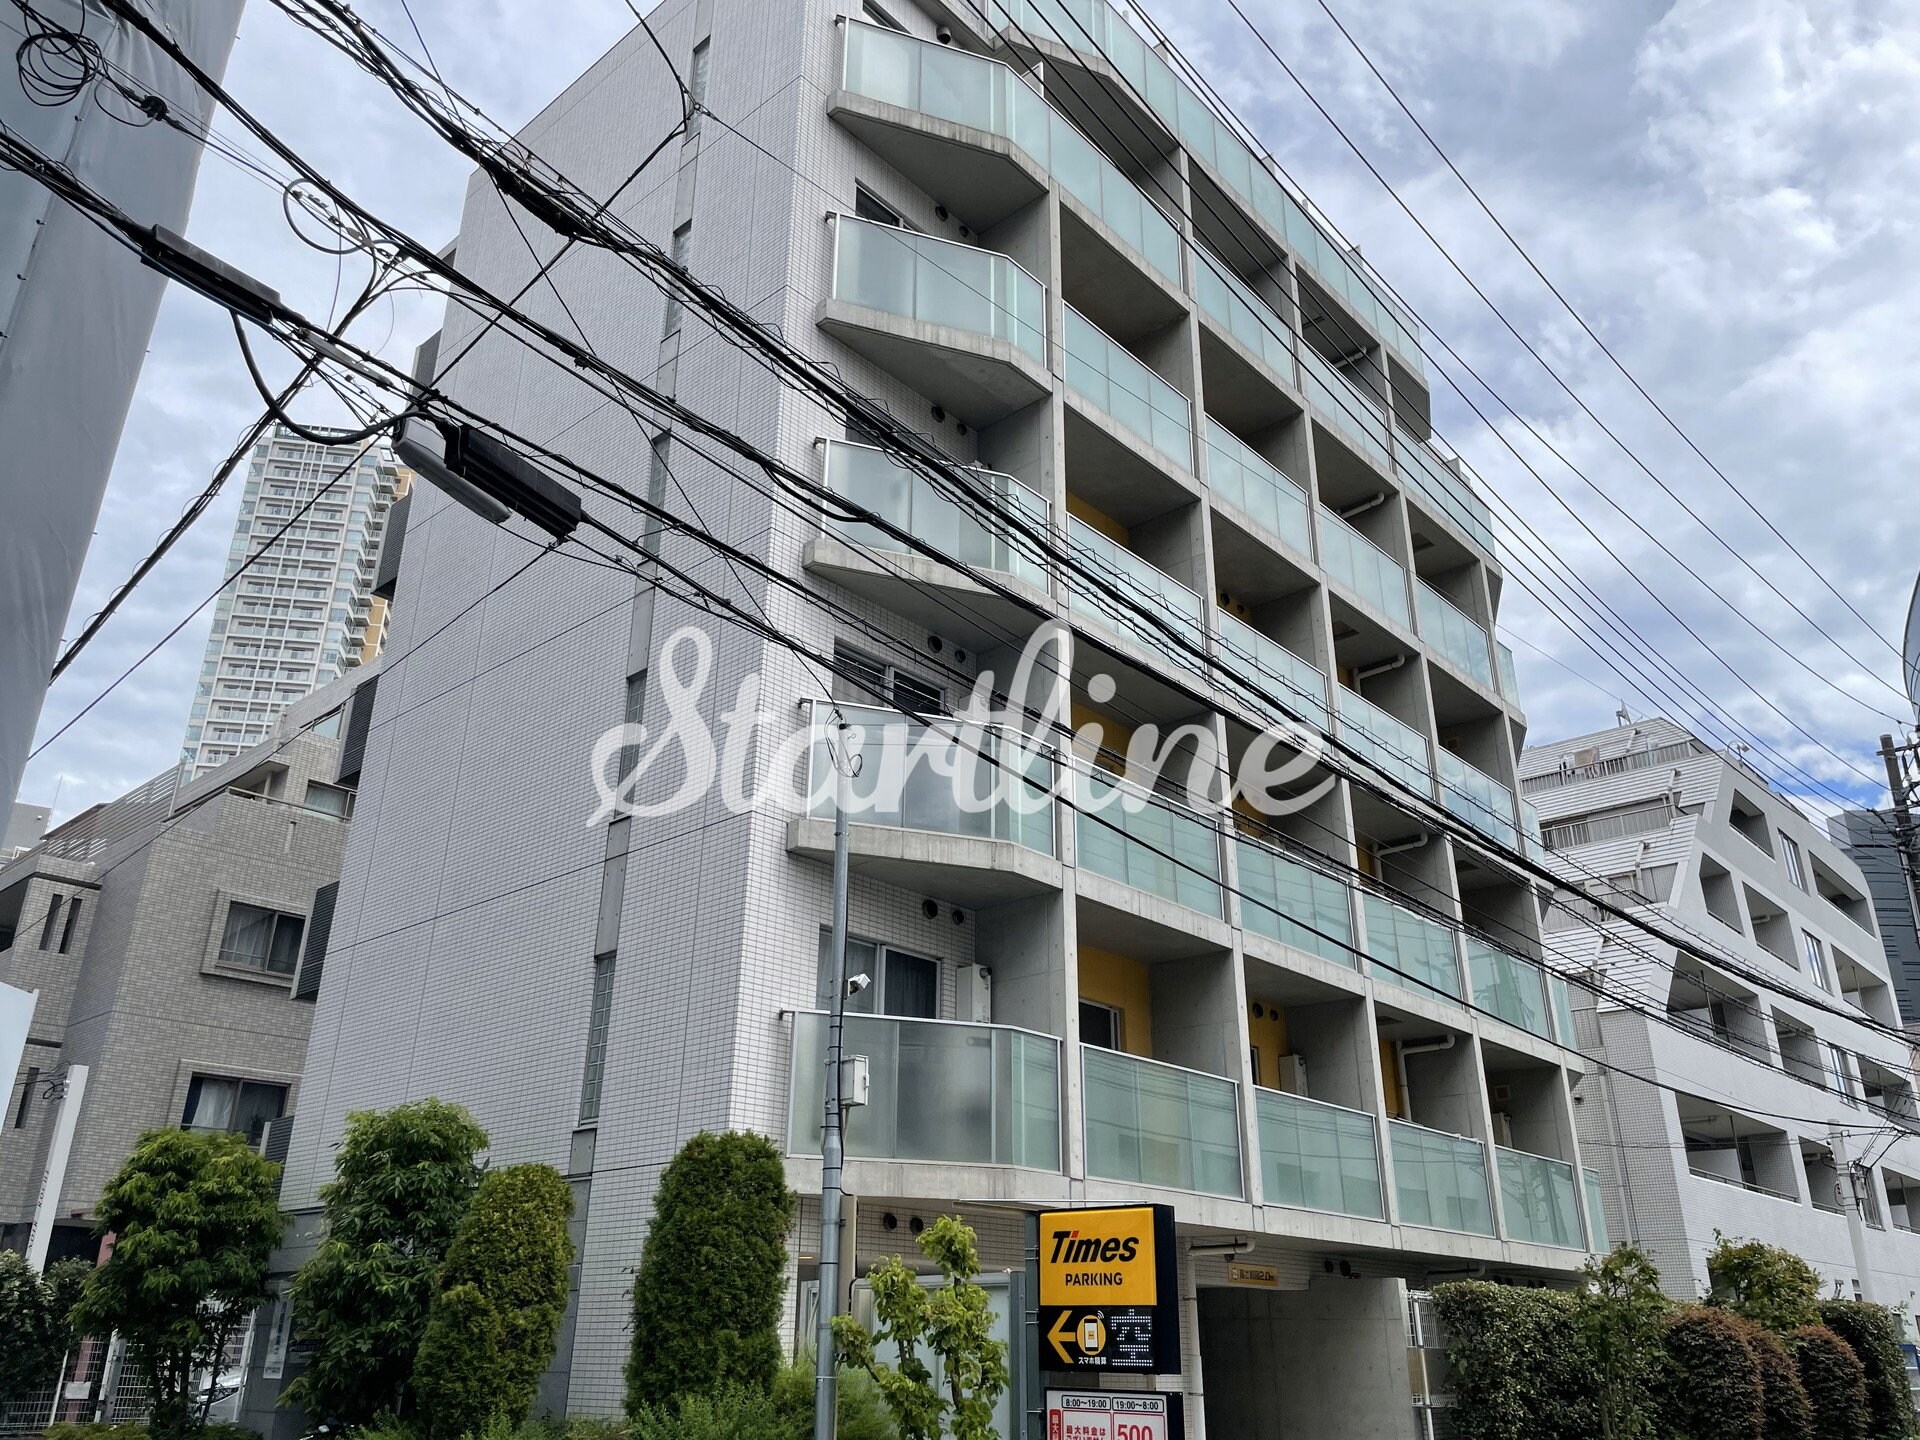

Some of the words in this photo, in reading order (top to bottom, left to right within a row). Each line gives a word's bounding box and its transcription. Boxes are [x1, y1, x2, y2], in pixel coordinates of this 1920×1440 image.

[1050, 1230, 1139, 1264] Times
[1065, 1272, 1123, 1287] PARKING
[1111, 1308, 1153, 1367] 空
[1066, 1425, 1106, 1436] 最大料金は
[1117, 1424, 1153, 1440] 500
